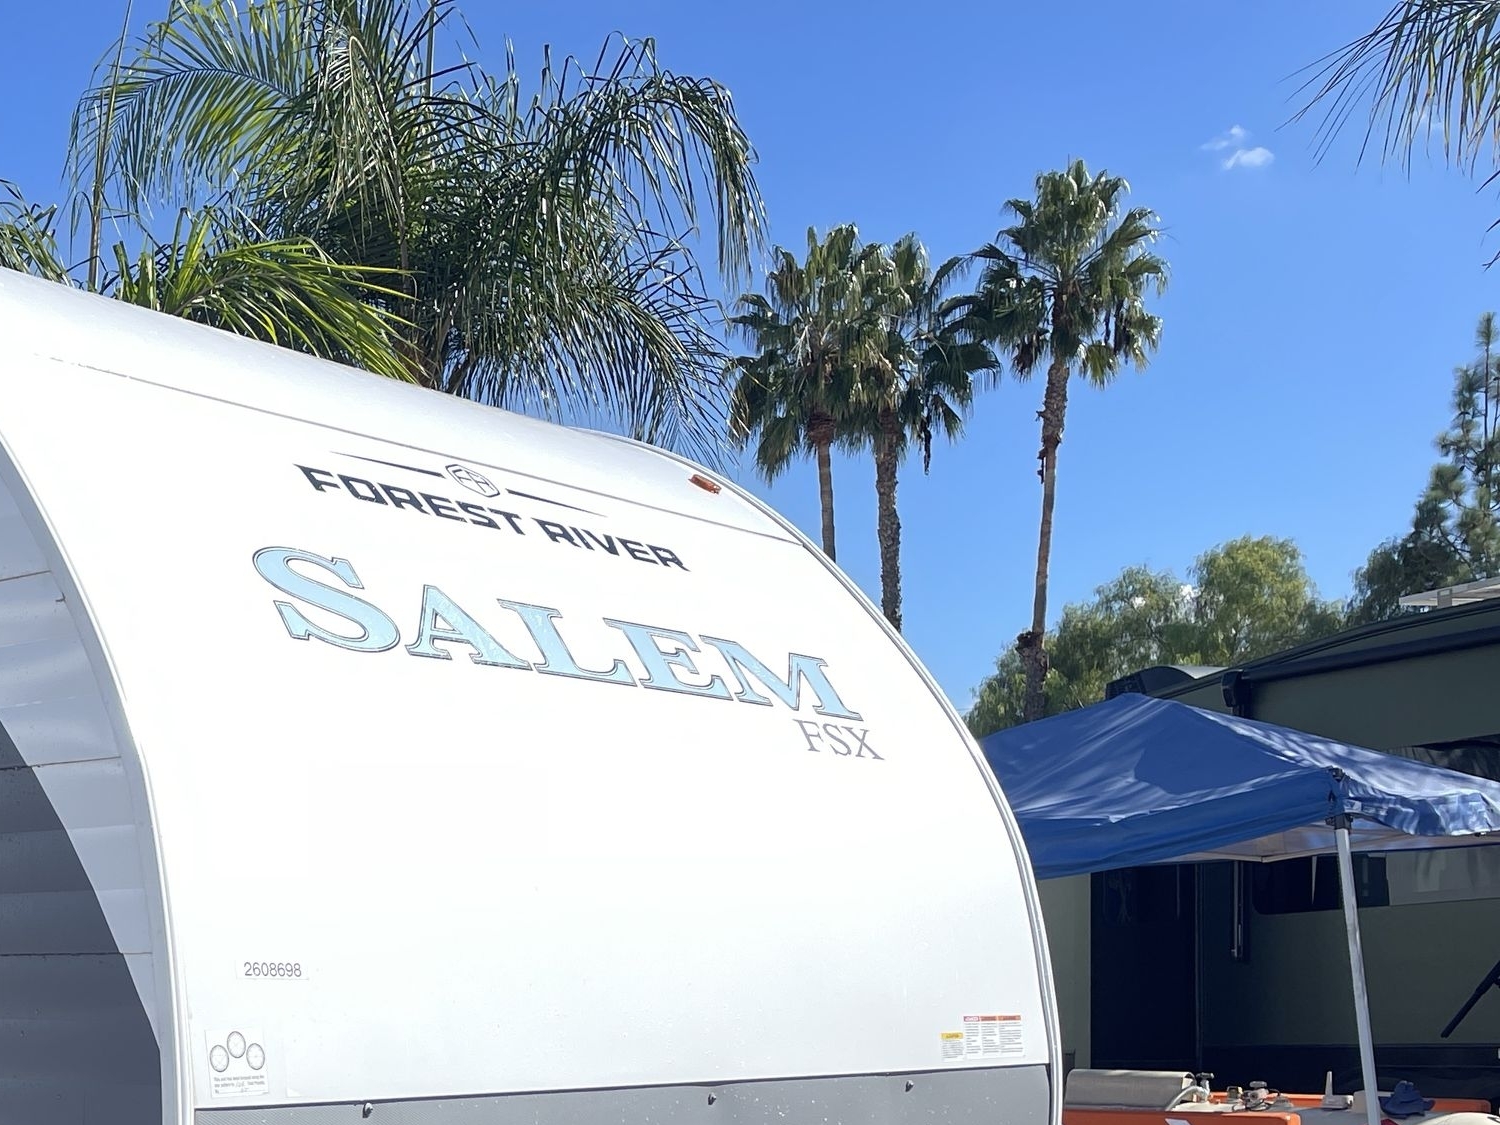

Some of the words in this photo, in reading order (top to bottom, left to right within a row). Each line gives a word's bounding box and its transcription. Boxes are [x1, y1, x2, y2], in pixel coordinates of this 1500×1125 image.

[293, 462, 525, 536] FOREST
[532, 517, 690, 572] RIVER
[252, 545, 864, 722] SALEM
[792, 719, 885, 761] FSX
[243, 961, 302, 977] 2608698
